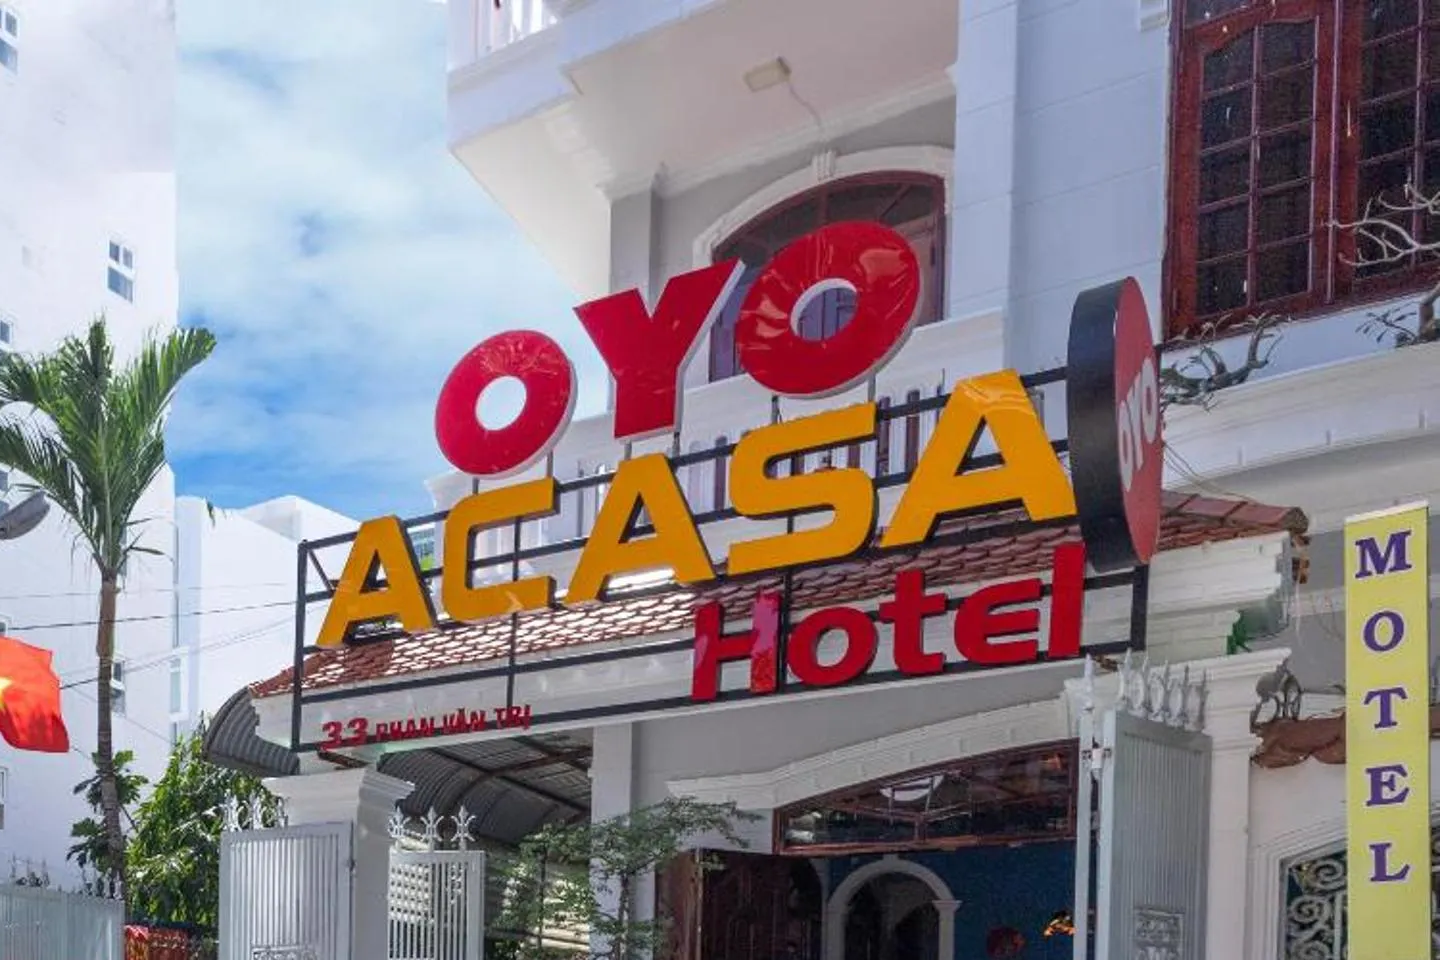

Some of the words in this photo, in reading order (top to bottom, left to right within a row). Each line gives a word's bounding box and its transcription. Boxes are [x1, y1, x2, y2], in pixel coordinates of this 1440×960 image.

[435, 220, 924, 479] OYO
[1118, 356, 1158, 493] OYO
[314, 368, 1081, 650] ACASA
[320, 717, 369, 750] 33
[376, 715, 435, 741] PHAN
[1354, 530, 1412, 886] MOTEL
